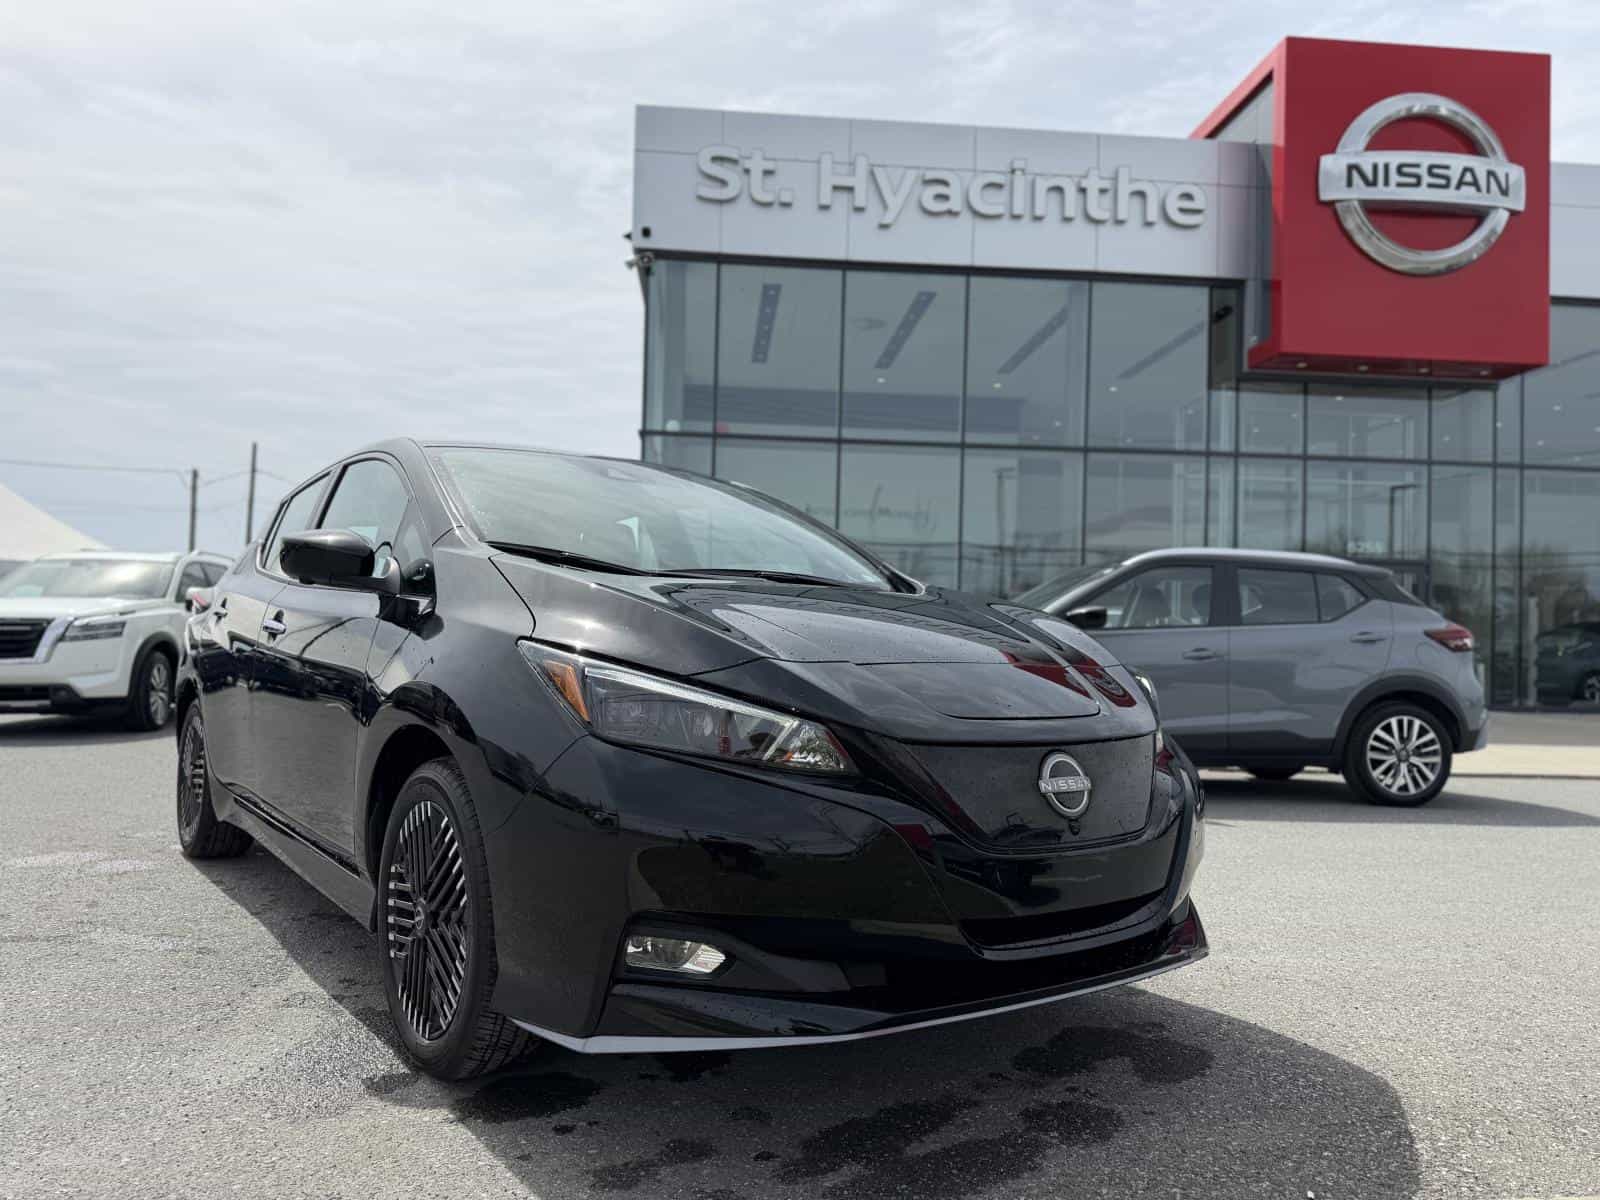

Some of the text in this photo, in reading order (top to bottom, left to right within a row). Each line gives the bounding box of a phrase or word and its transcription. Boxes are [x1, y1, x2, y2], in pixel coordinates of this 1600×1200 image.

[696, 144, 1207, 228] St. Hyacinthe
[1345, 161, 1510, 197] NISSAN
